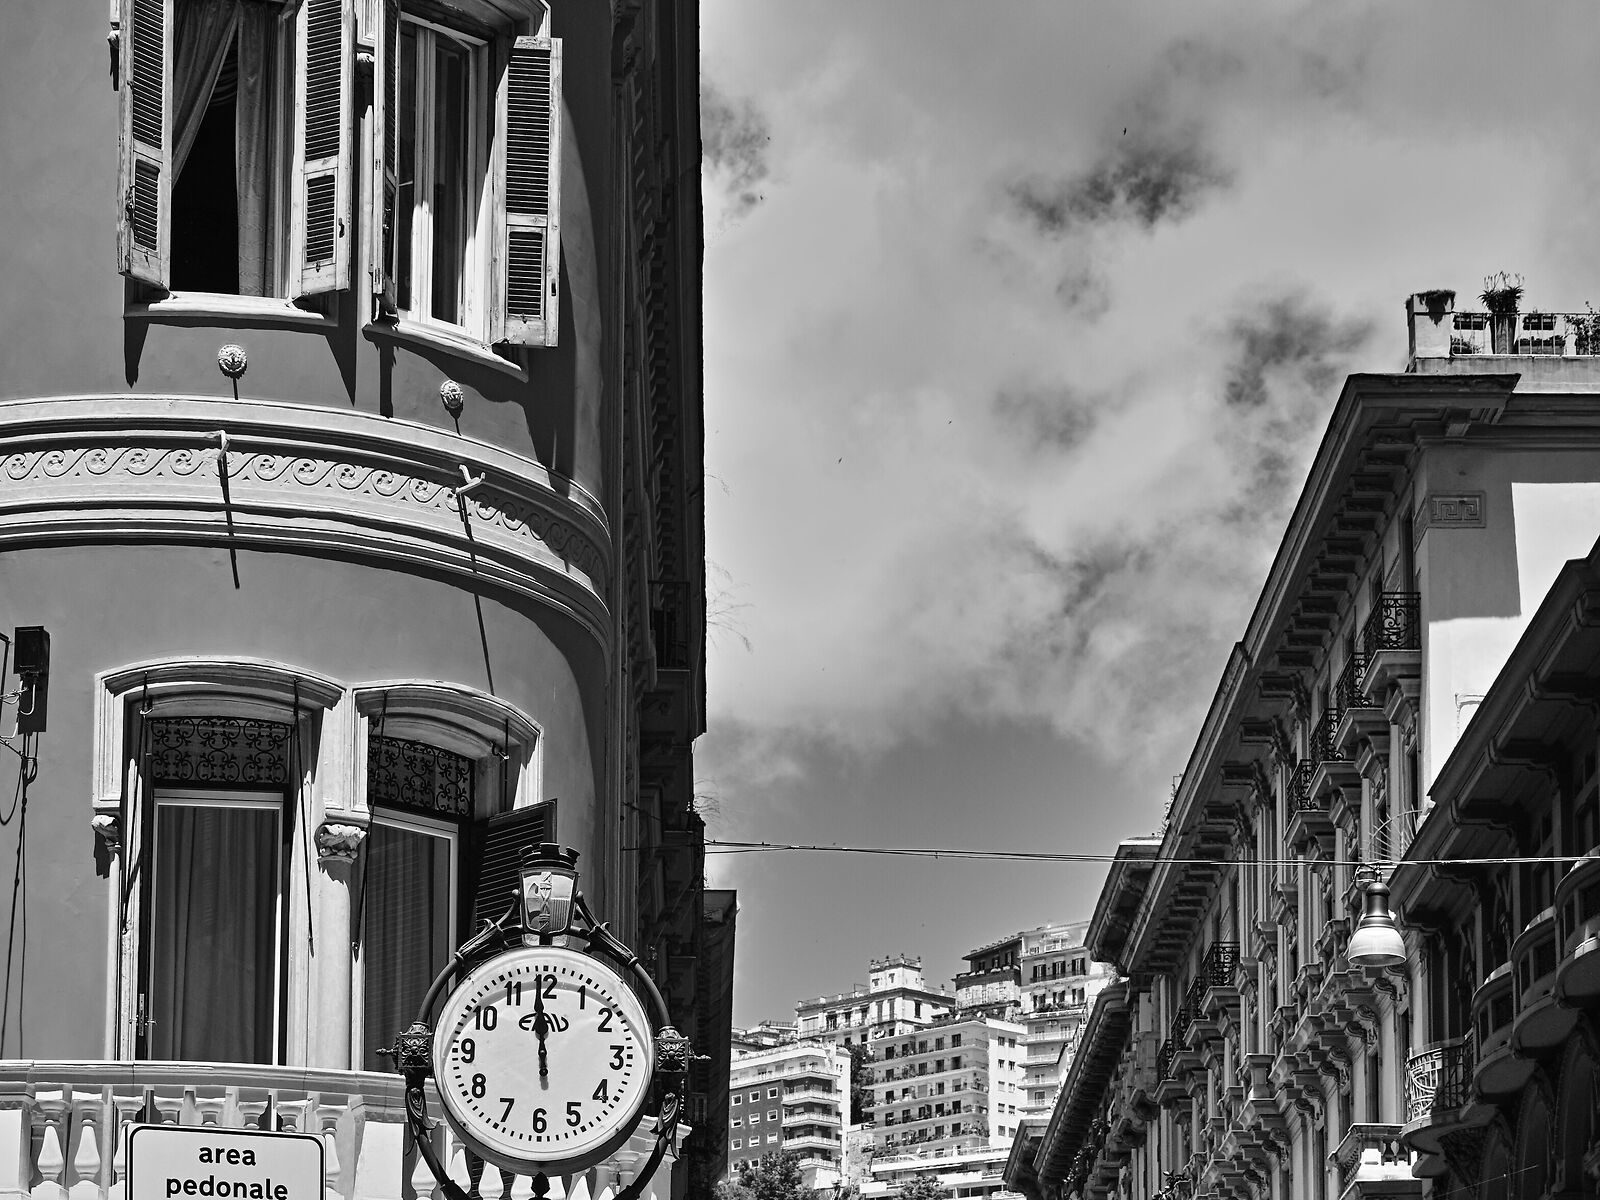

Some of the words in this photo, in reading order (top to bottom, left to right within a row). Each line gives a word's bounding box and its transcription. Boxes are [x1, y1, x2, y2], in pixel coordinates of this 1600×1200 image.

[504, 981, 522, 1006] 11
[534, 974, 557, 999] 12
[577, 985, 586, 1010] 1
[473, 1005, 498, 1031] 10
[597, 1007, 613, 1033] 2
[460, 1038, 476, 1064] 9
[609, 1045, 625, 1070] 3
[471, 1073, 487, 1099] 8
[592, 1078, 609, 1104] 4
[499, 1097, 515, 1123] 7
[532, 1107, 548, 1134] 6
[566, 1101, 582, 1127] 5
[199, 1146, 257, 1166] area
[166, 1175, 289, 1200] pedonale
